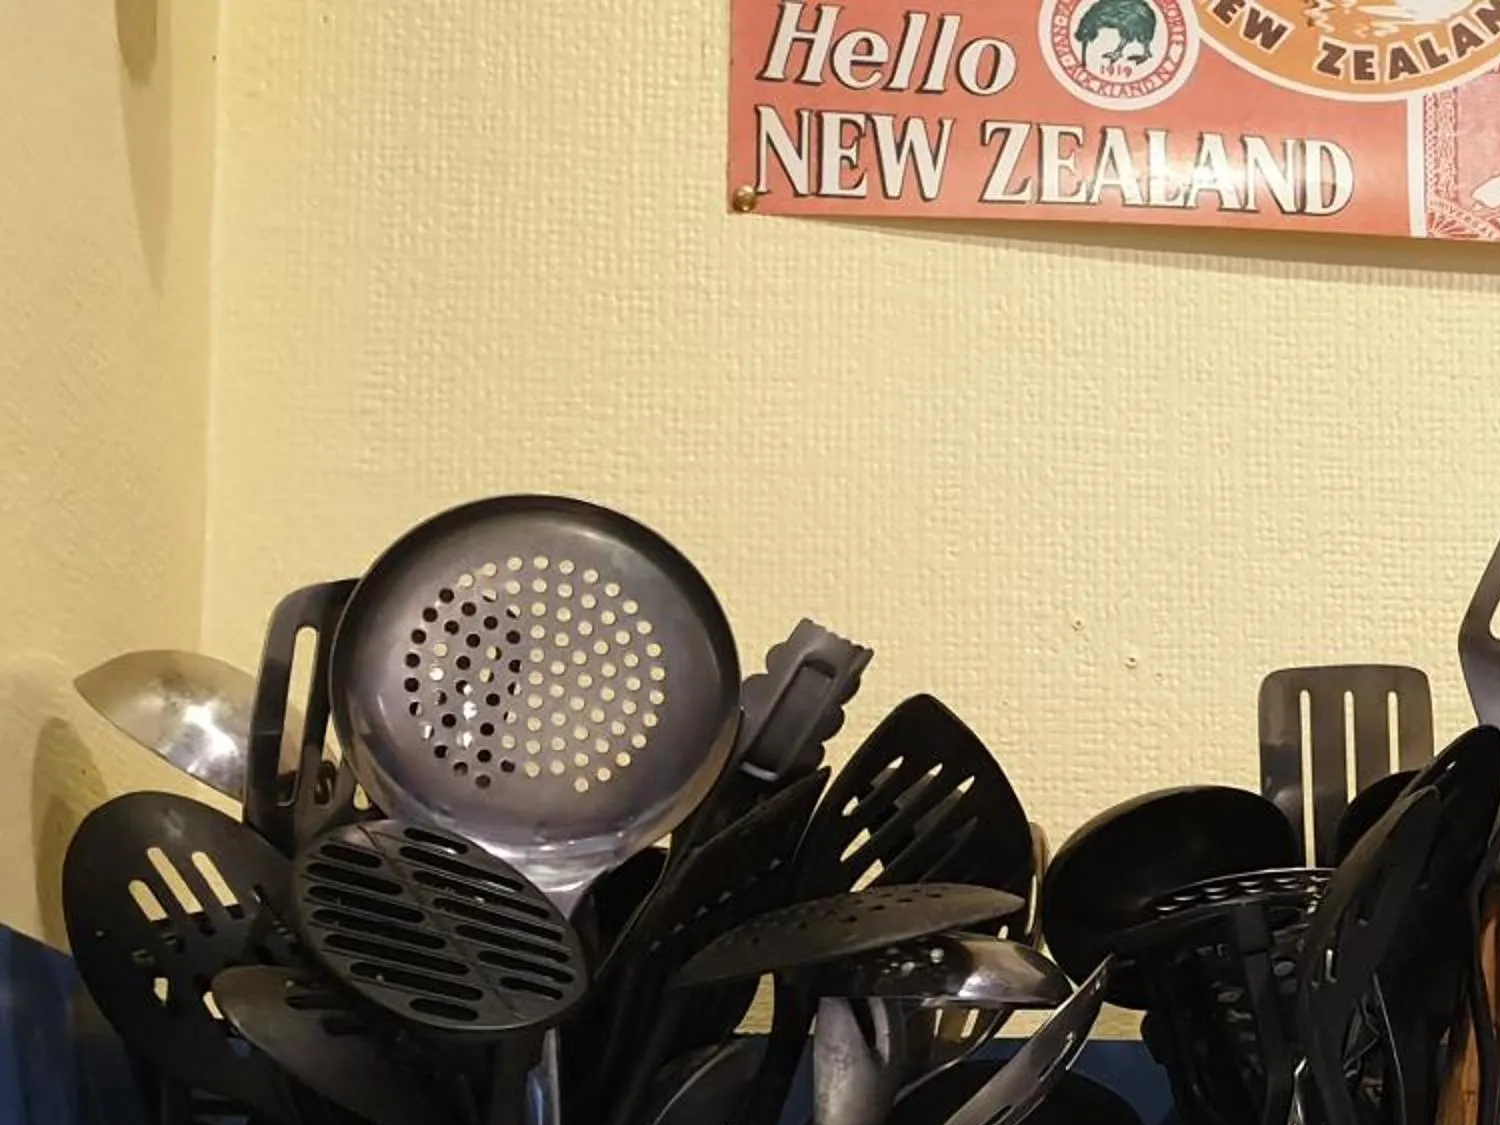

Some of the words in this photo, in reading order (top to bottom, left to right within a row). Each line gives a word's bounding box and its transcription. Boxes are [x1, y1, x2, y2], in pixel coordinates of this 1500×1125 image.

[757, 2, 1017, 97] Hello
[1212, 0, 1288, 50] EW
[754, 104, 957, 201] NEW
[978, 120, 1354, 216] ZEALAND
